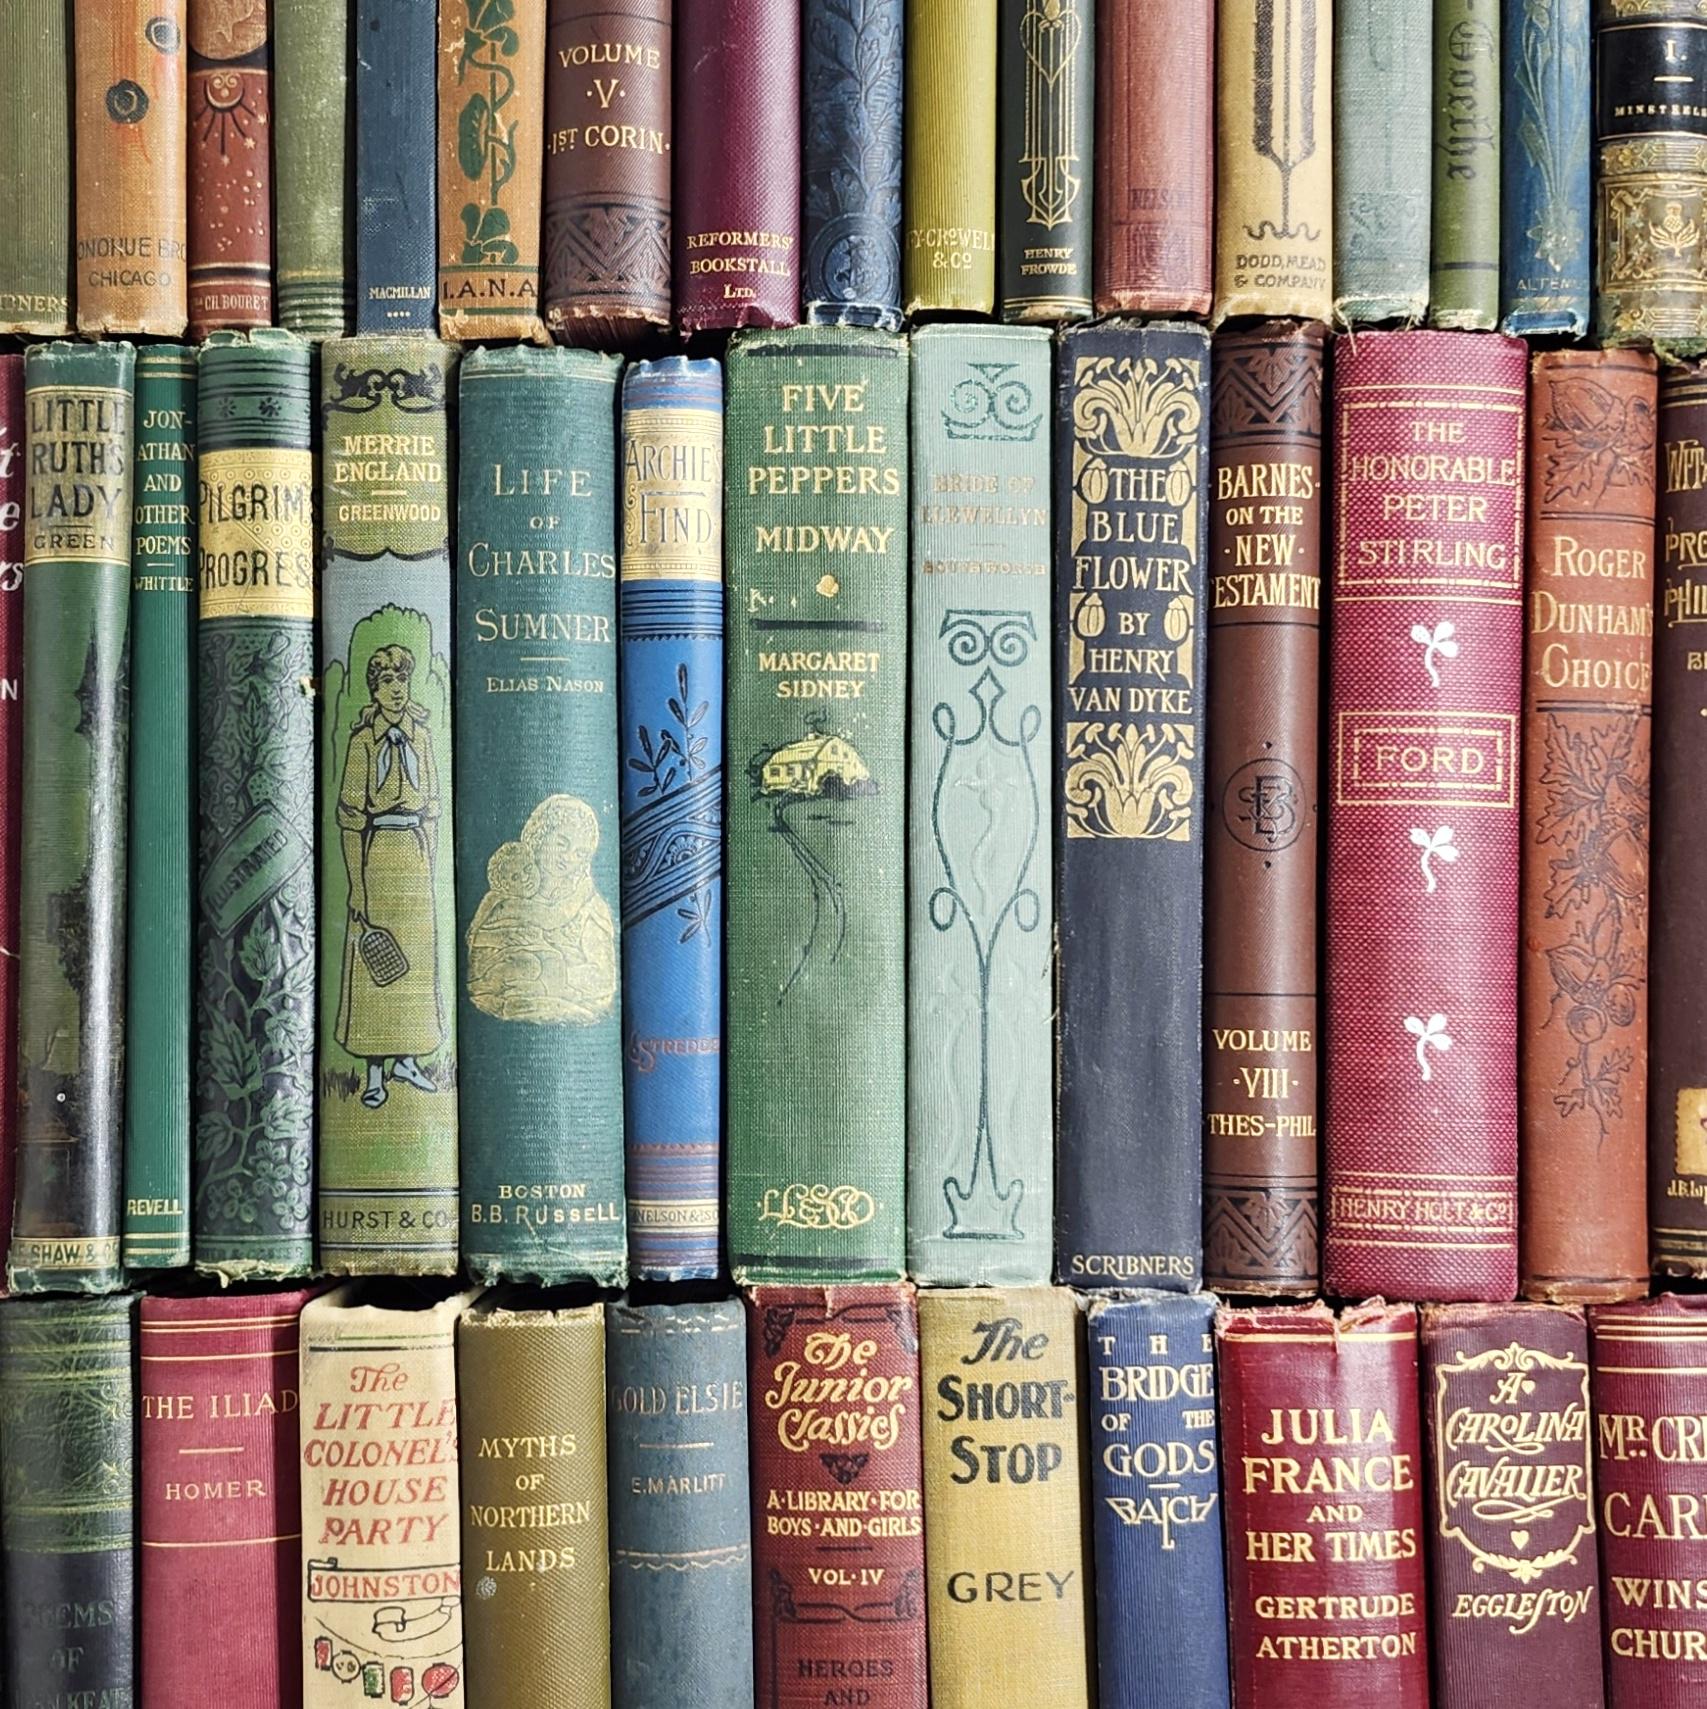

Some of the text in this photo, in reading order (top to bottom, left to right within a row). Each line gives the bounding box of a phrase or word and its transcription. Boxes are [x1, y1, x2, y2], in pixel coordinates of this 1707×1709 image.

[559, 44, 660, 69] VOLUME
[690, 258, 790, 276] BOOKSTALL
[1024, 248, 1073, 260] HENRY
[89, 269, 171, 289] CHICAGO
[1021, 263, 1077, 276] FROWDE
[1234, 273, 1327, 291] & COMPANY
[369, 287, 431, 300] MACMILLAN
[1516, 278, 1584, 291] ALTEM
[782, 384, 866, 412] FIVE
[31, 398, 126, 433] LITTLE
[143, 410, 192, 430] JON-
[344, 435, 436, 456] MERRIE
[764, 425, 888, 454] LITTLE
[1410, 421, 1466, 444] THE
[32, 440, 126, 476] RUTH'S
[136, 442, 195, 462] ATHAN
[143, 474, 182, 492] AND
[335, 462, 441, 483] ENGLAND
[494, 464, 592, 498] LIFE
[749, 467, 901, 496] PEPPERS
[933, 475, 998, 494] BRIDE
[1109, 467, 1167, 503] THE
[1217, 463, 1314, 501] BARNES
[1350, 455, 1515, 487] HONORABLE
[31, 484, 122, 520] LADY
[135, 504, 195, 525] OTHER
[339, 504, 441, 523] GREENWOOD
[1226, 505, 1304, 527] ON THE
[1383, 494, 1488, 525] PETER
[529, 515, 560, 530] OF
[640, 491, 713, 545] FIND
[1092, 511, 1179, 544] BLUE
[33, 533, 115, 551] GREEN
[136, 536, 192, 556] POEMS
[755, 526, 894, 554] MIDWAY
[468, 541, 616, 580] CHARLES
[1357, 539, 1507, 571] STIRLING
[1551, 535, 1647, 580] ROGER
[134, 576, 194, 593] WHITTLE
[1072, 555, 1195, 597] FLOWER
[1211, 573, 1320, 610] ESTAMENT
[475, 607, 612, 644] SUMNER
[1118, 612, 1151, 637] BY
[758, 651, 880, 673] MARGARET
[1089, 648, 1175, 683] HENRY
[1542, 643, 1651, 692] CHOICE
[487, 676, 605, 694] ELIAS NASON
[776, 680, 865, 700] SIDNEY
[1067, 687, 1193, 715] VAN DYKE
[1376, 744, 1485, 776] FORD
[1212, 1028, 1312, 1052] VOLUME
[498, 1183, 587, 1200] BOSTON
[127, 1199, 183, 1216] REVELL
[323, 1210, 393, 1229] HURST
[399, 1210, 416, 1228] &
[471, 1202, 621, 1224] B.B. RUSSELL
[633, 1209, 687, 1223] NELSON
[1337, 1197, 1408, 1221] HENRY
[1414, 1199, 1468, 1222] HOLT
[31, 1243, 80, 1264] SHAW
[1071, 1255, 1195, 1281] SCRIBNERS
[804, 1330, 877, 1371] The
[961, 1317, 1049, 1366] The
[350, 1363, 408, 1393] The
[765, 1361, 912, 1408] Junior
[1099, 1363, 1215, 1402] BRIDGE
[1490, 1372, 1522, 1404] A
[143, 1389, 298, 1420] THE ILIAD
[675, 1380, 743, 1415] ELSIE
[313, 1400, 457, 1431] LITTLE
[777, 1403, 906, 1453] Classics
[1101, 1409, 1215, 1432] OF THE
[1261, 1408, 1396, 1445] JULIA
[1446, 1403, 1588, 1452] CAROLINA
[478, 1433, 577, 1459] MYTHS
[950, 1435, 1063, 1485] STOP
[1102, 1439, 1217, 1478] GODS
[516, 1474, 544, 1490] OF
[1242, 1454, 1414, 1495] FRANCE
[1446, 1456, 1588, 1508] CAVALIER
[165, 1480, 267, 1501] HOMER
[323, 1476, 449, 1506] HOUSE
[471, 1500, 591, 1528] NORTHERN
[1105, 1493, 1218, 1549] BALCH
[1307, 1504, 1363, 1524] AND
[318, 1513, 451, 1546] PARTY
[1246, 1529, 1416, 1563] HER TIMES
[486, 1547, 576, 1574] LANDS
[311, 1570, 460, 1599] JOHNSTON
[947, 1569, 1075, 1604] GREY
[1255, 1593, 1415, 1620] GERTRUDE
[1452, 1586, 1594, 1635] EGGLESTON
[1256, 1632, 1417, 1660] ATHERTON
[798, 1658, 894, 1679] HEROES
[823, 1688, 871, 1706] AND
